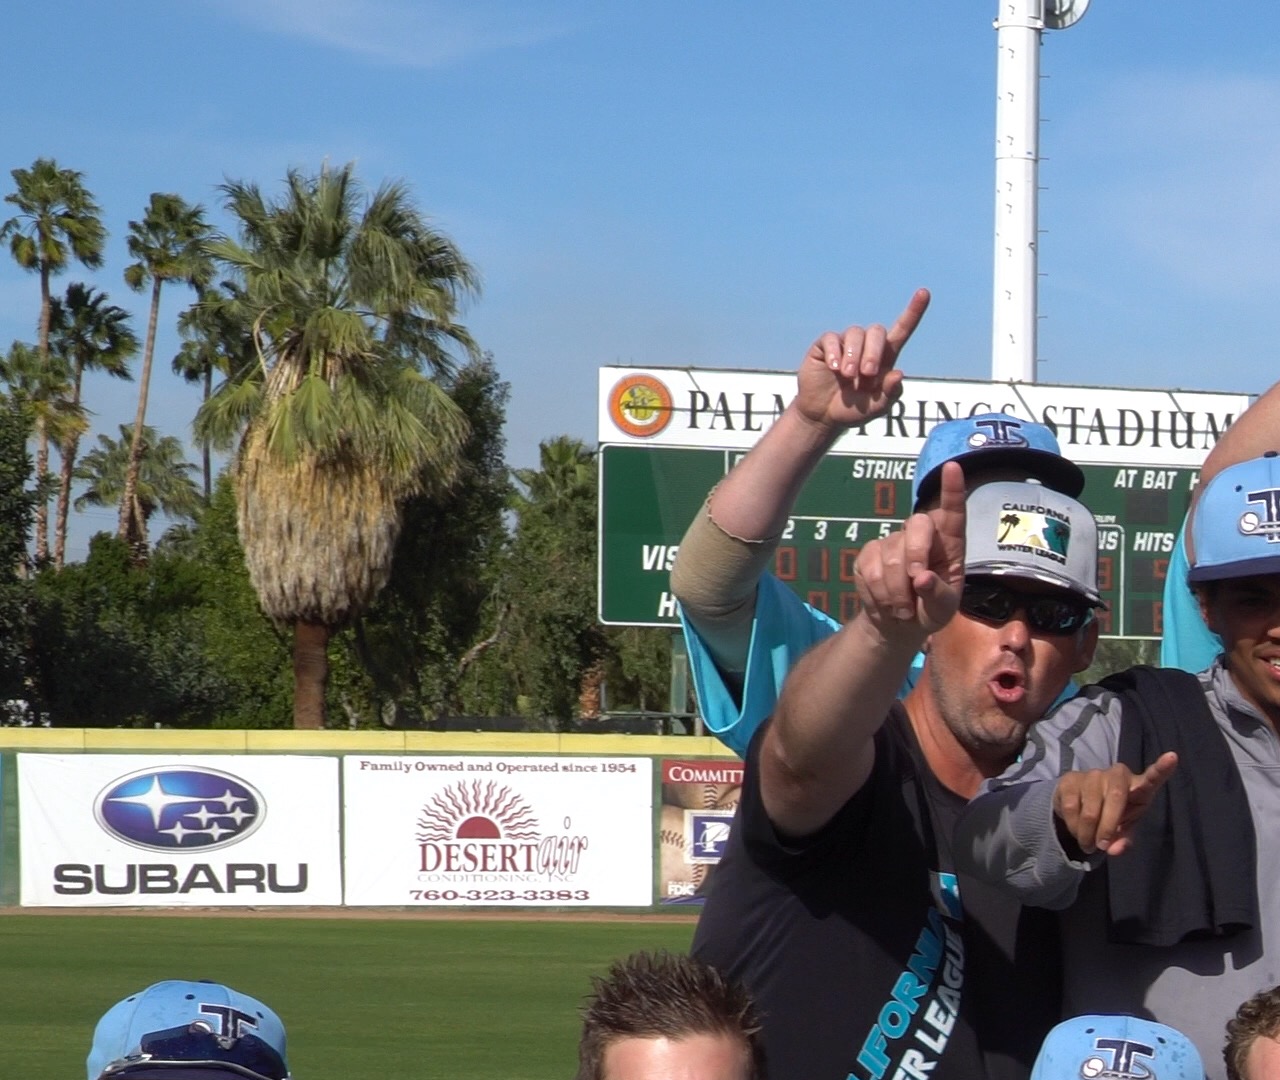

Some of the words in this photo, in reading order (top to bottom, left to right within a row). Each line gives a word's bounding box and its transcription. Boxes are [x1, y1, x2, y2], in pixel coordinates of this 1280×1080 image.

[1114, 469, 1137, 489] AT
[1142, 470, 1178, 490] BAT
[1002, 503, 1071, 525] CALIFORNIA
[813, 521, 828, 541] 3
[845, 522, 860, 542] 4
[1133, 531, 1175, 552] HITS
[997, 544, 1034, 556] WINTER
[360, 761, 412, 774] Family
[415, 761, 465, 773] Owned
[467, 761, 494, 773] and
[496, 762, 559, 775] Operated
[562, 762, 598, 774] since
[600, 763, 637, 774] 1954
[419, 843, 539, 874] DESERT
[536, 816, 589, 876] air
[53, 863, 309, 896] SUBARU
[409, 890, 591, 902] 760-323-3383
